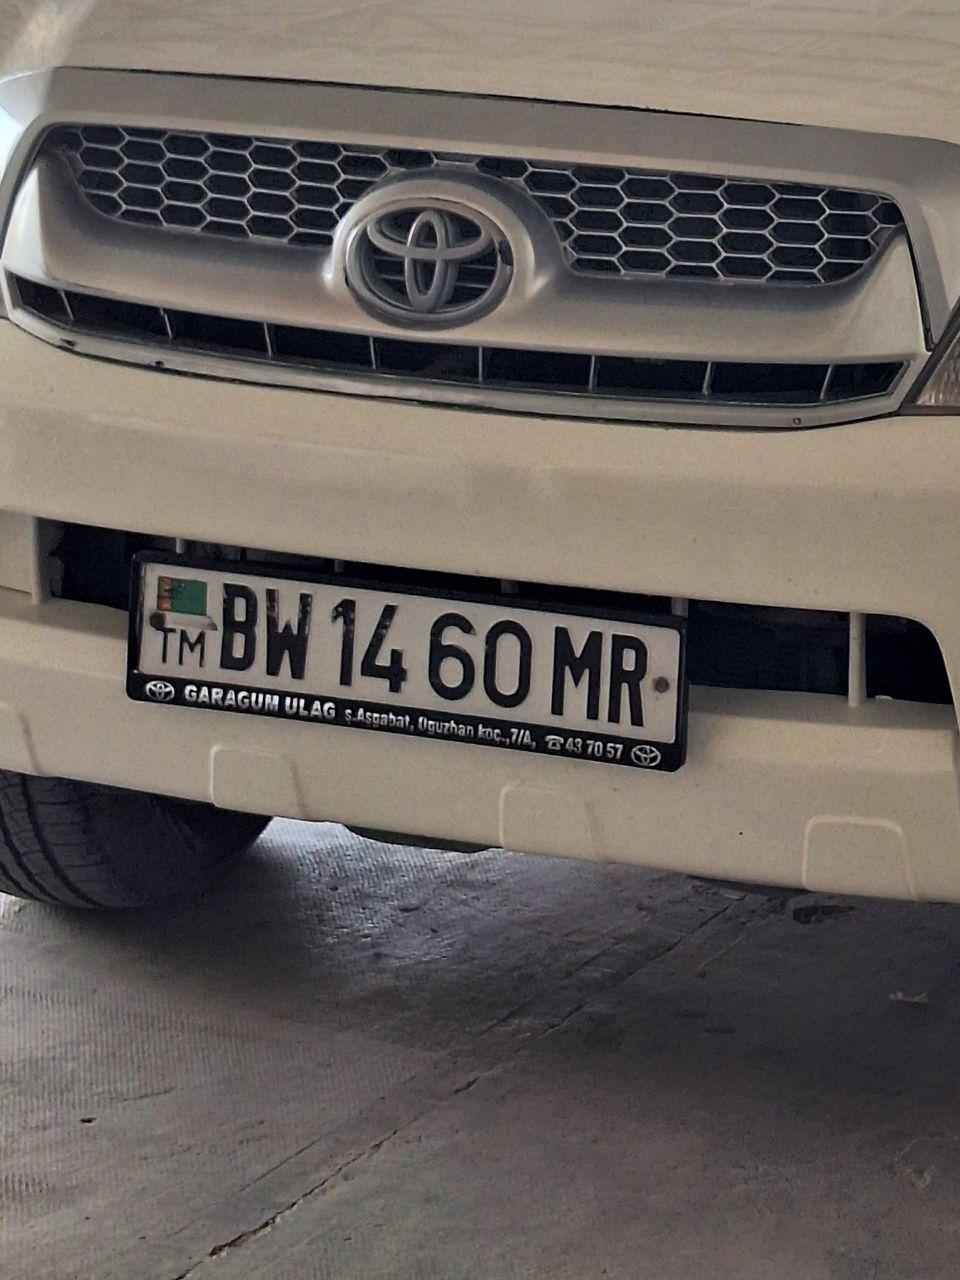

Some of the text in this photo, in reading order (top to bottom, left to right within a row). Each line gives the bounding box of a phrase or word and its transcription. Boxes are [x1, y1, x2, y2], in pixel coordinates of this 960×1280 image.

[154, 628, 206, 667] TM
[220, 583, 648, 727] BW 14 60 MR
[184, 685, 279, 712] GARAGUM
[285, 698, 336, 719] ULAG
